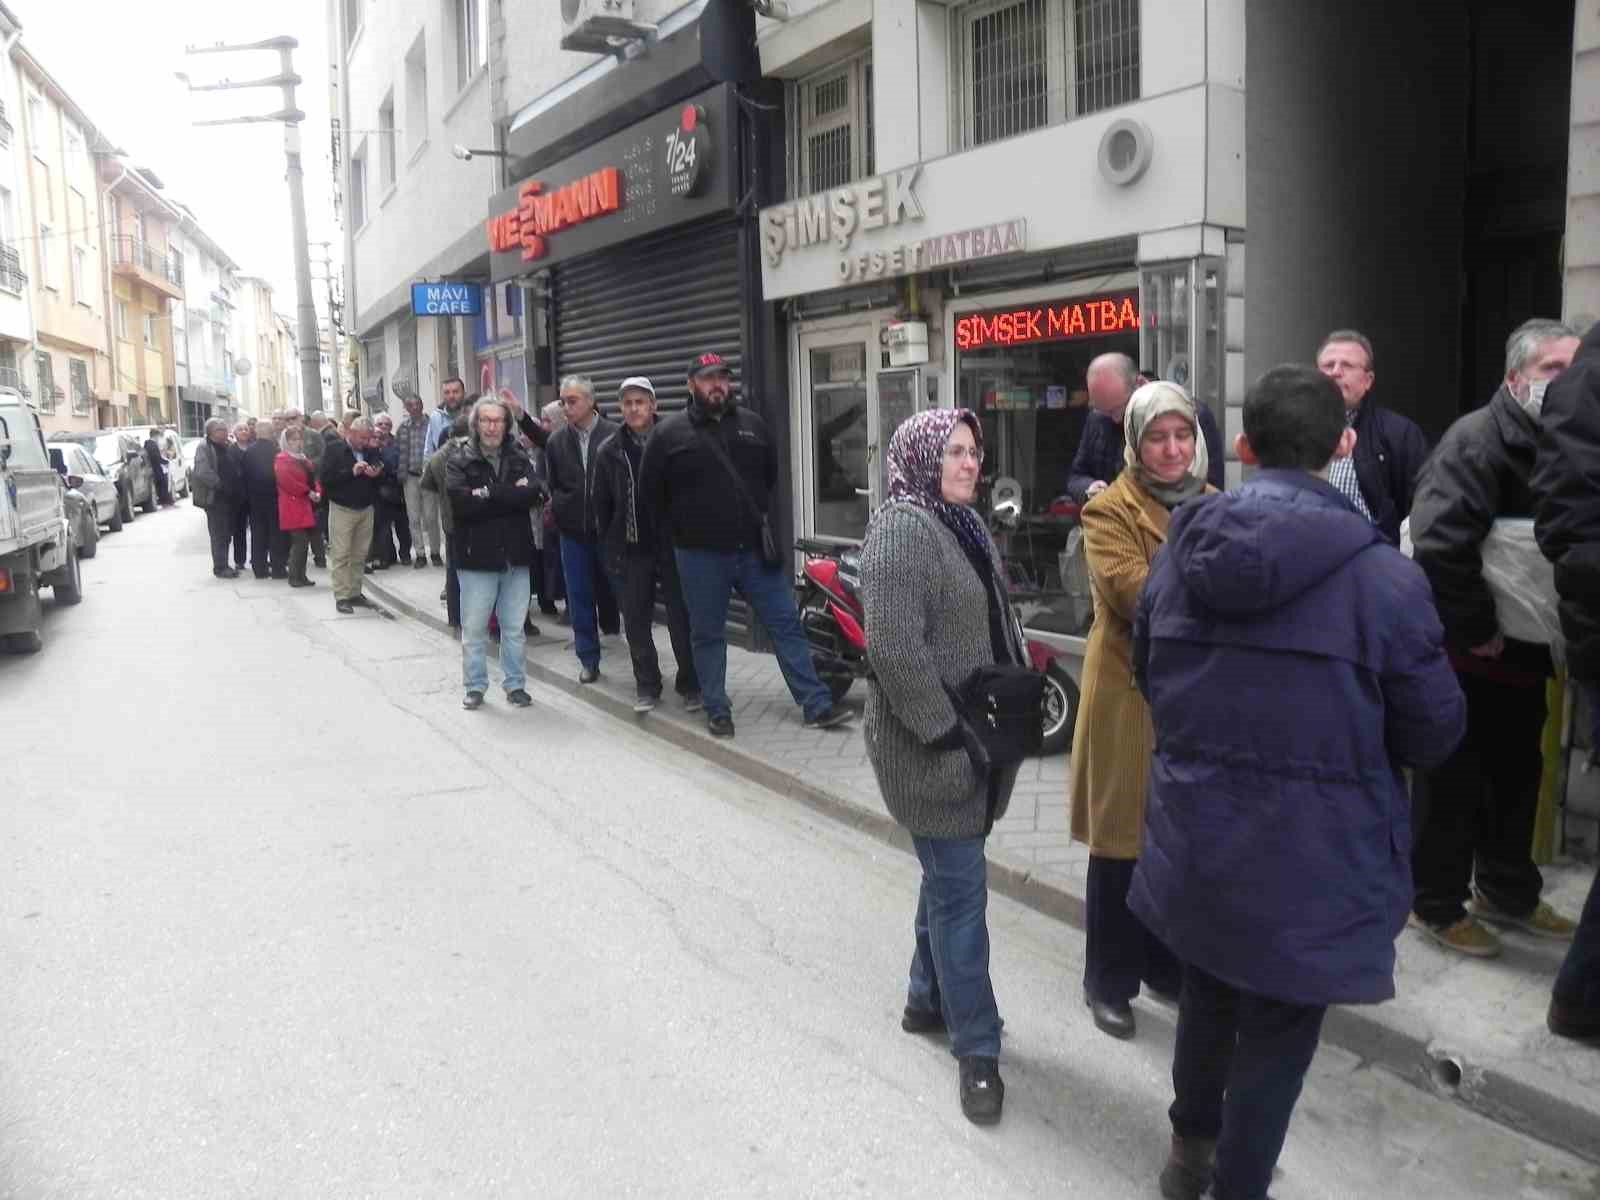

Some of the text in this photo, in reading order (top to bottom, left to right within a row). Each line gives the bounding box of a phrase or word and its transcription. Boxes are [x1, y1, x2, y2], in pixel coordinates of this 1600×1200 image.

[665, 128, 697, 175] 7/24
[838, 217, 1026, 281] OFSET MATBAA
[426, 300, 472, 314] CAFE
[957, 298, 1142, 350] ŞİMŞEK MATBA
